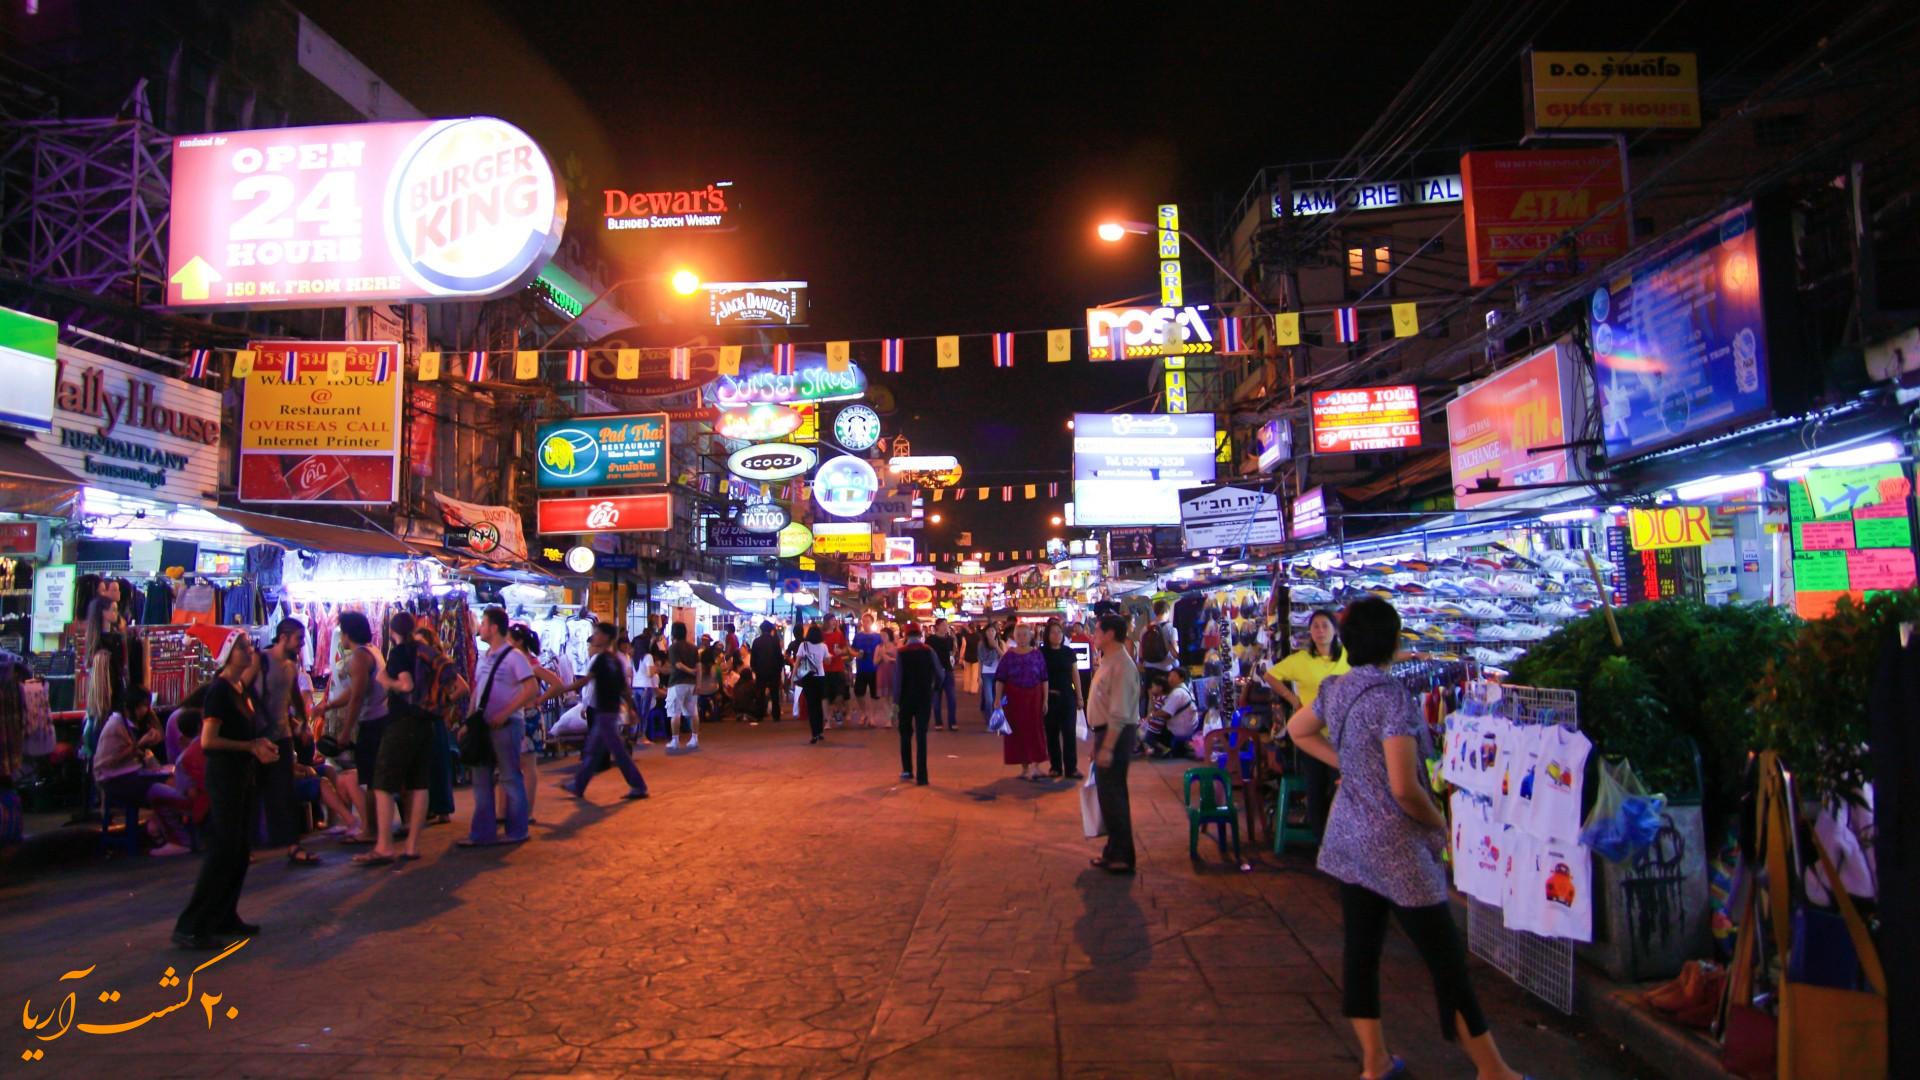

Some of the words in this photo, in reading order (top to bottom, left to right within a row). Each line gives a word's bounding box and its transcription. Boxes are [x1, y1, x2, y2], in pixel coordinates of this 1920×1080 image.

[1547, 102, 1612, 117] GUEST
[1620, 102, 1692, 117] HOUSE
[231, 141, 365, 174] OPEN
[410, 145, 533, 213] BURGER
[1343, 178, 1460, 208] ORIENTAL
[229, 170, 362, 241] 24
[414, 174, 538, 258] KING
[1510, 189, 1590, 220] ATM
[1160, 206, 1178, 255] SIAM
[226, 238, 362, 267] HOURS
[226, 281, 256, 297] 150
[259, 282, 280, 297] M.
[285, 279, 341, 295] FROM
[346, 275, 401, 292] HERE
[718, 295, 747, 318] JACK
[745, 291, 790, 319] DANIEL'S
[1374, 387, 1414, 402] TOUR
[126, 377, 220, 446] House
[280, 404, 361, 416] Restaurant
[1512, 395, 1548, 450] ATM
[249, 420, 337, 433] OVERSEAS
[346, 420, 390, 433] CALL
[599, 424, 628, 444] Pad
[631, 423, 664, 442] Thai
[60, 426, 189, 472] RESTAURANT
[257, 436, 319, 447] Internet
[326, 436, 380, 447] Printer
[601, 441, 662, 452] RESTAURANT
[1457, 440, 1500, 471] EXCHANGE
[742, 512, 785, 527] TATTOO
[1631, 507, 1711, 547] DIOR
[714, 536, 733, 546] Yui
[736, 535, 773, 547] Silver
